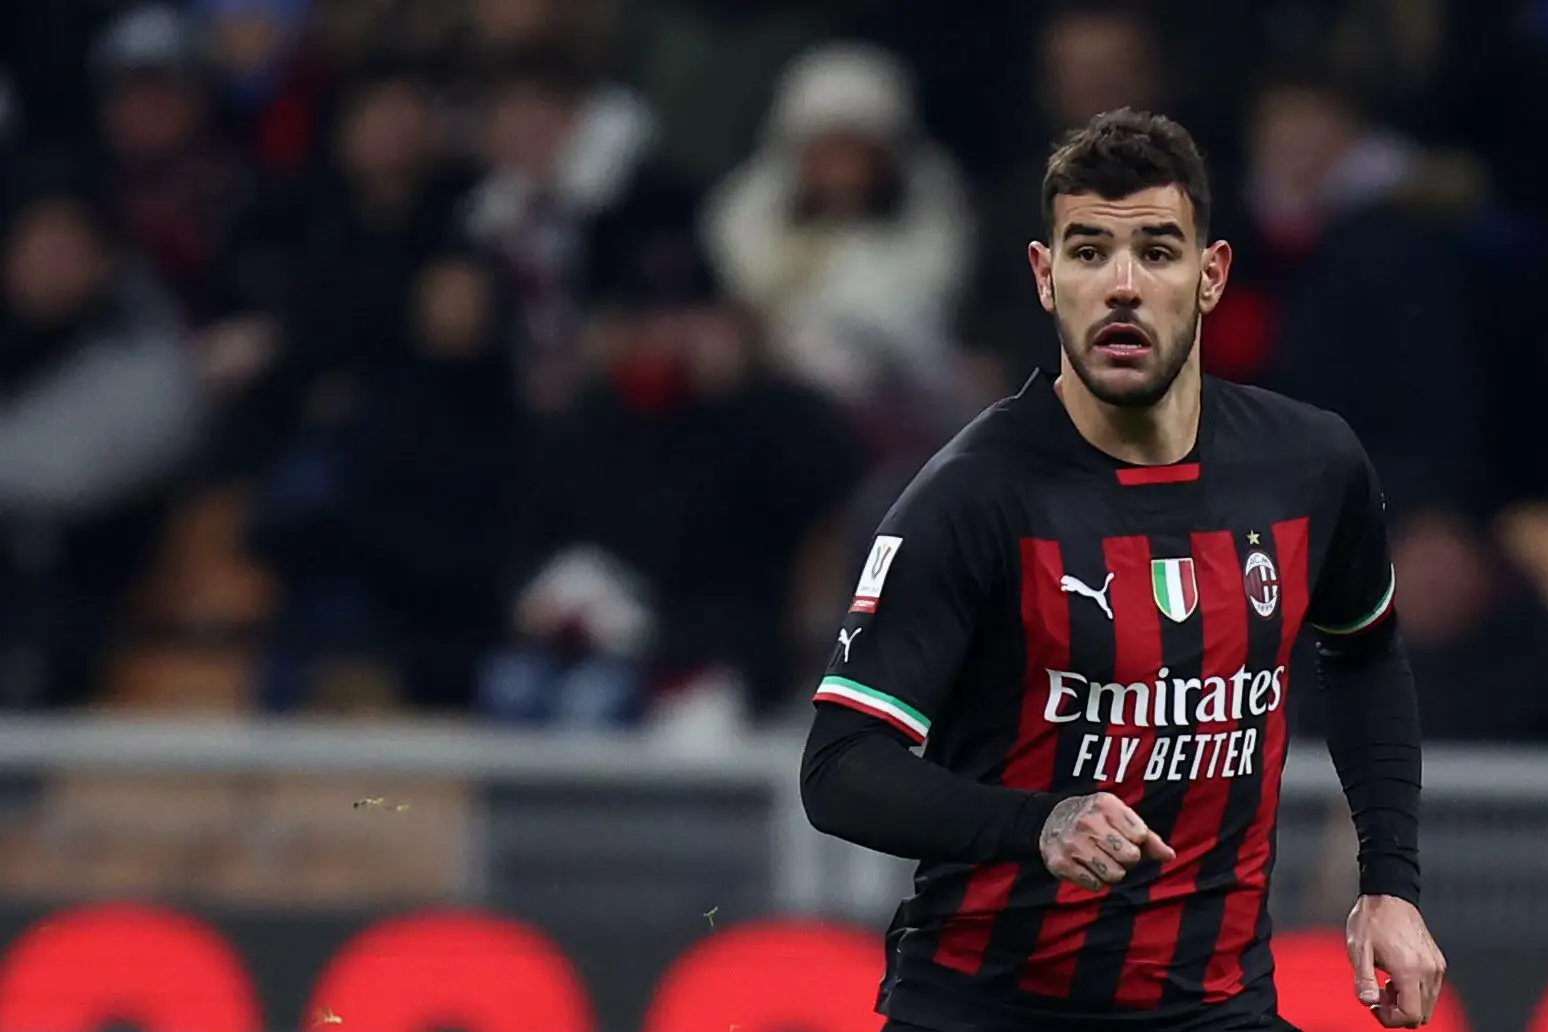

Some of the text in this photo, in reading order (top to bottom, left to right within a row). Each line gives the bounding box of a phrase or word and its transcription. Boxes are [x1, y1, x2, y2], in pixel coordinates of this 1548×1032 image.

[1044, 663, 1284, 727] Emirates
[1072, 727, 1257, 783] FLY BETTER
